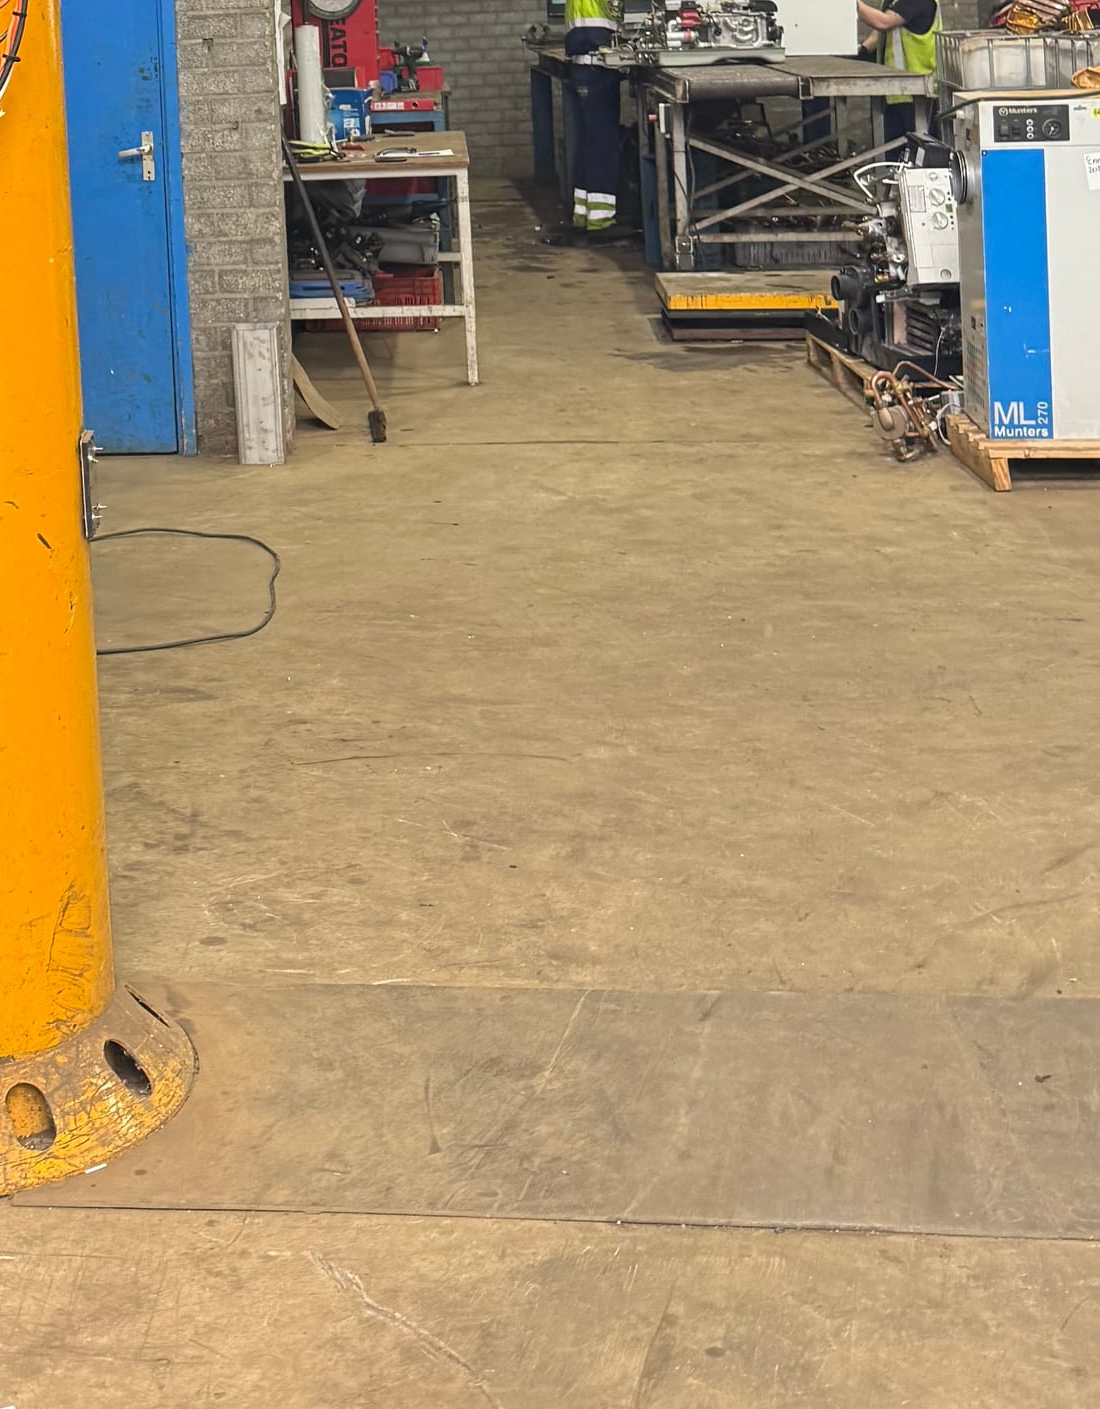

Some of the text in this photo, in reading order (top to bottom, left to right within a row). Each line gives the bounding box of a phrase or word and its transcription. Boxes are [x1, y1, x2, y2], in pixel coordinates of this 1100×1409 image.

[994, 401, 1049, 425] ML 270
[994, 425, 1049, 437] Munters
